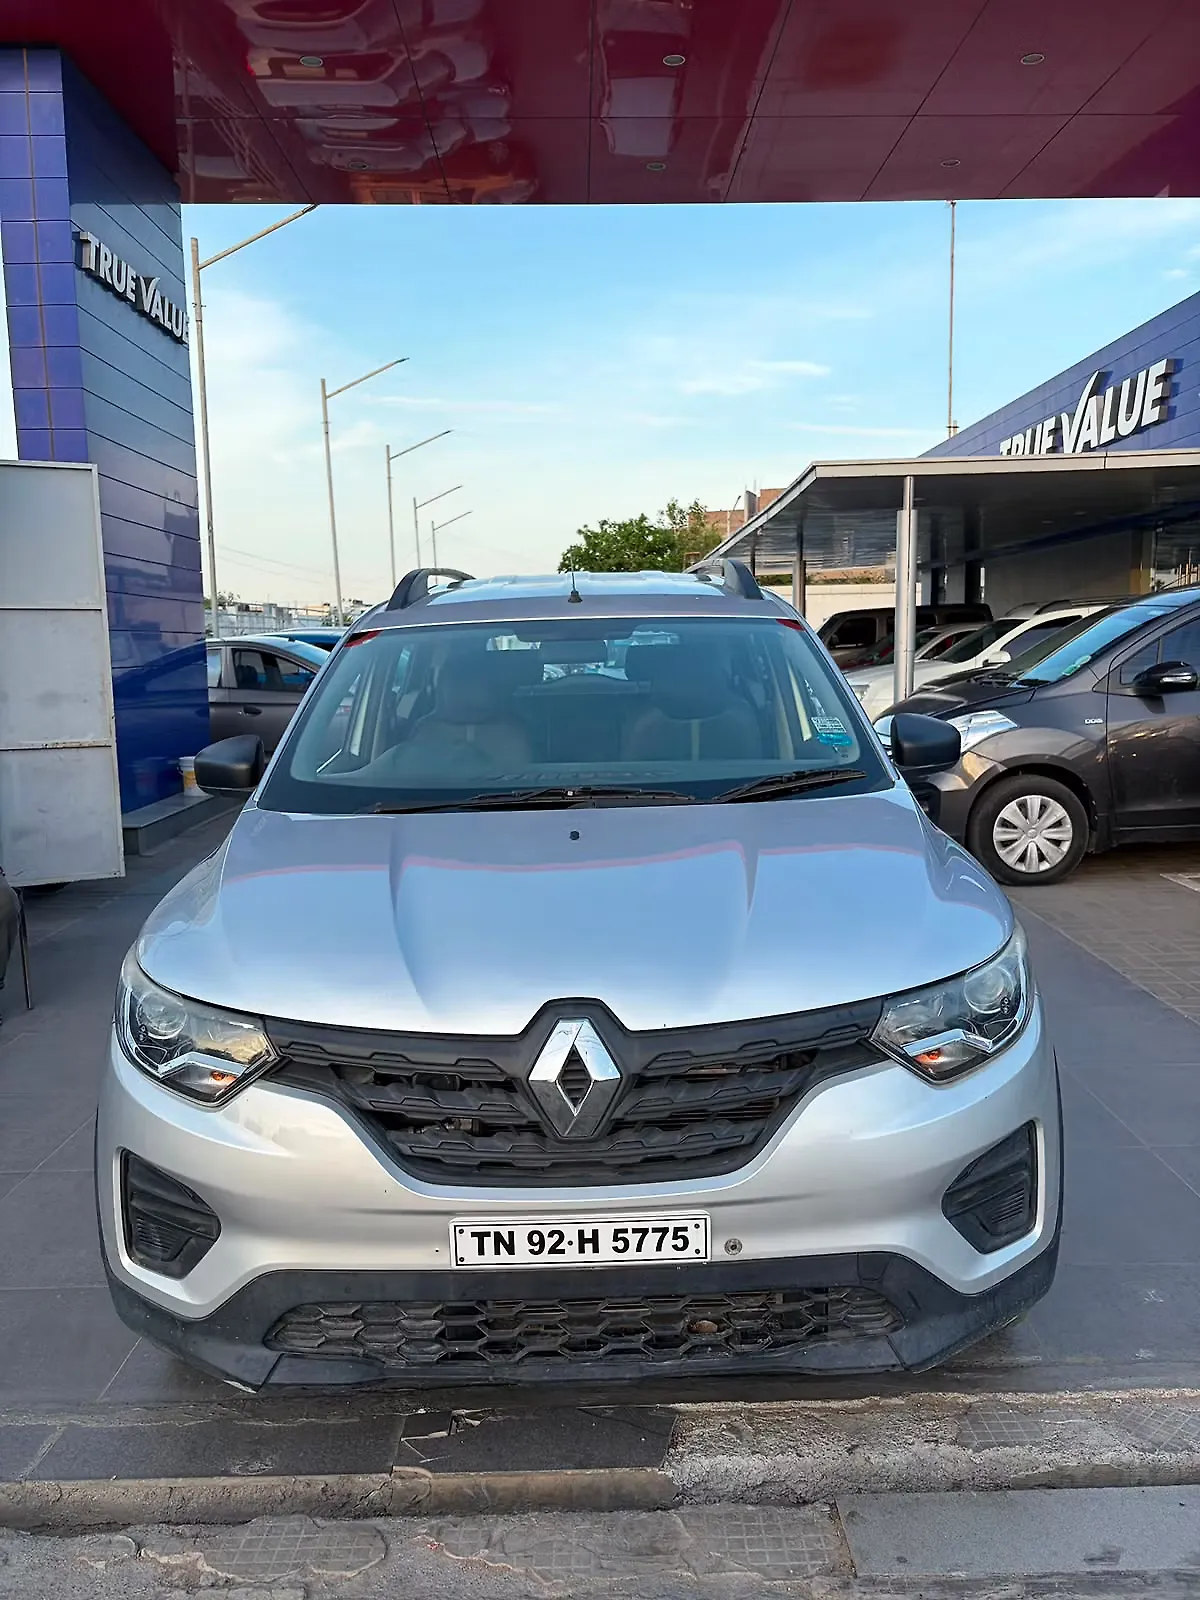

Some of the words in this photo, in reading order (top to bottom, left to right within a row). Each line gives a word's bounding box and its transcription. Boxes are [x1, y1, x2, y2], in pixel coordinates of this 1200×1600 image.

[79, 231, 136, 303] TRUE
[139, 275, 190, 345] VALUE
[1061, 359, 1170, 454] VALUE
[470, 1231, 516, 1256] TN
[527, 1230, 566, 1255] 92
[577, 1229, 600, 1254] H
[611, 1226, 690, 1254] 5775
